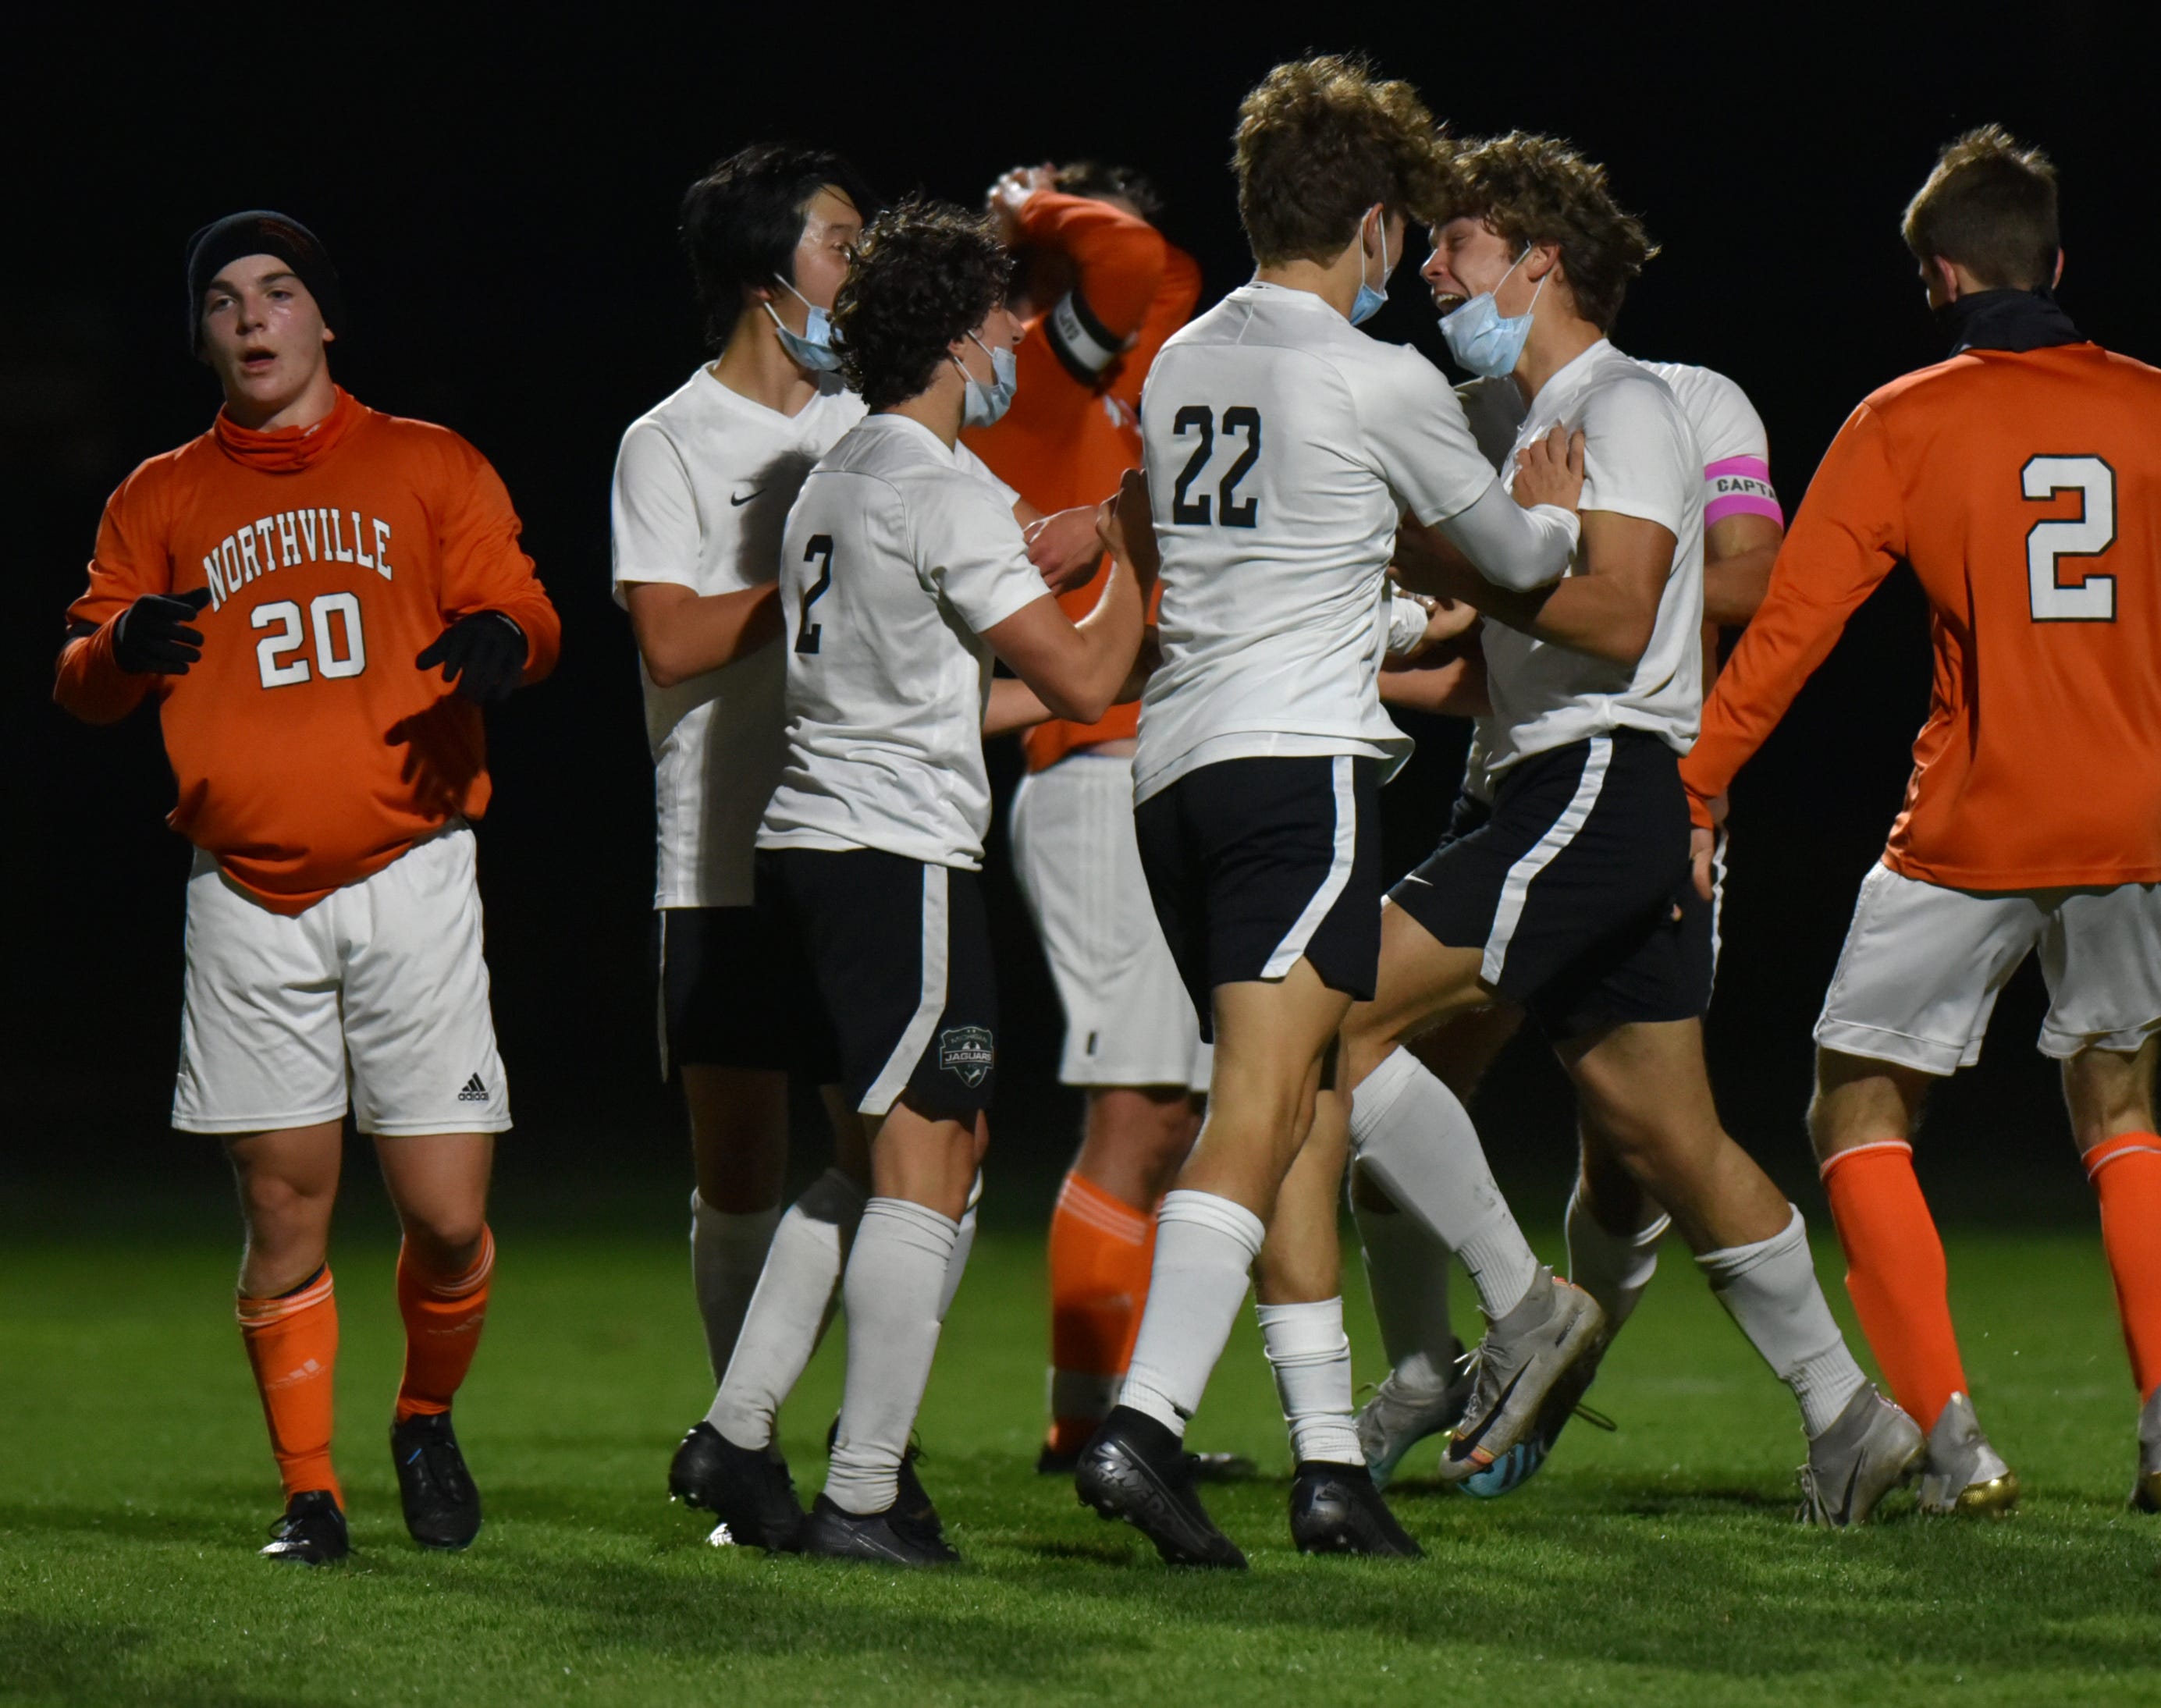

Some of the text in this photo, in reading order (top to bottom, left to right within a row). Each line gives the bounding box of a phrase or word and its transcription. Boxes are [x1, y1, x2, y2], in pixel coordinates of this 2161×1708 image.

[1173, 405, 1261, 528] 22
[203, 508, 392, 613] NORTHVILLE
[794, 534, 833, 654] 2
[2019, 453, 2118, 623] 2
[251, 591, 367, 691] 20
[944, 1052, 992, 1062] JAGUARS
